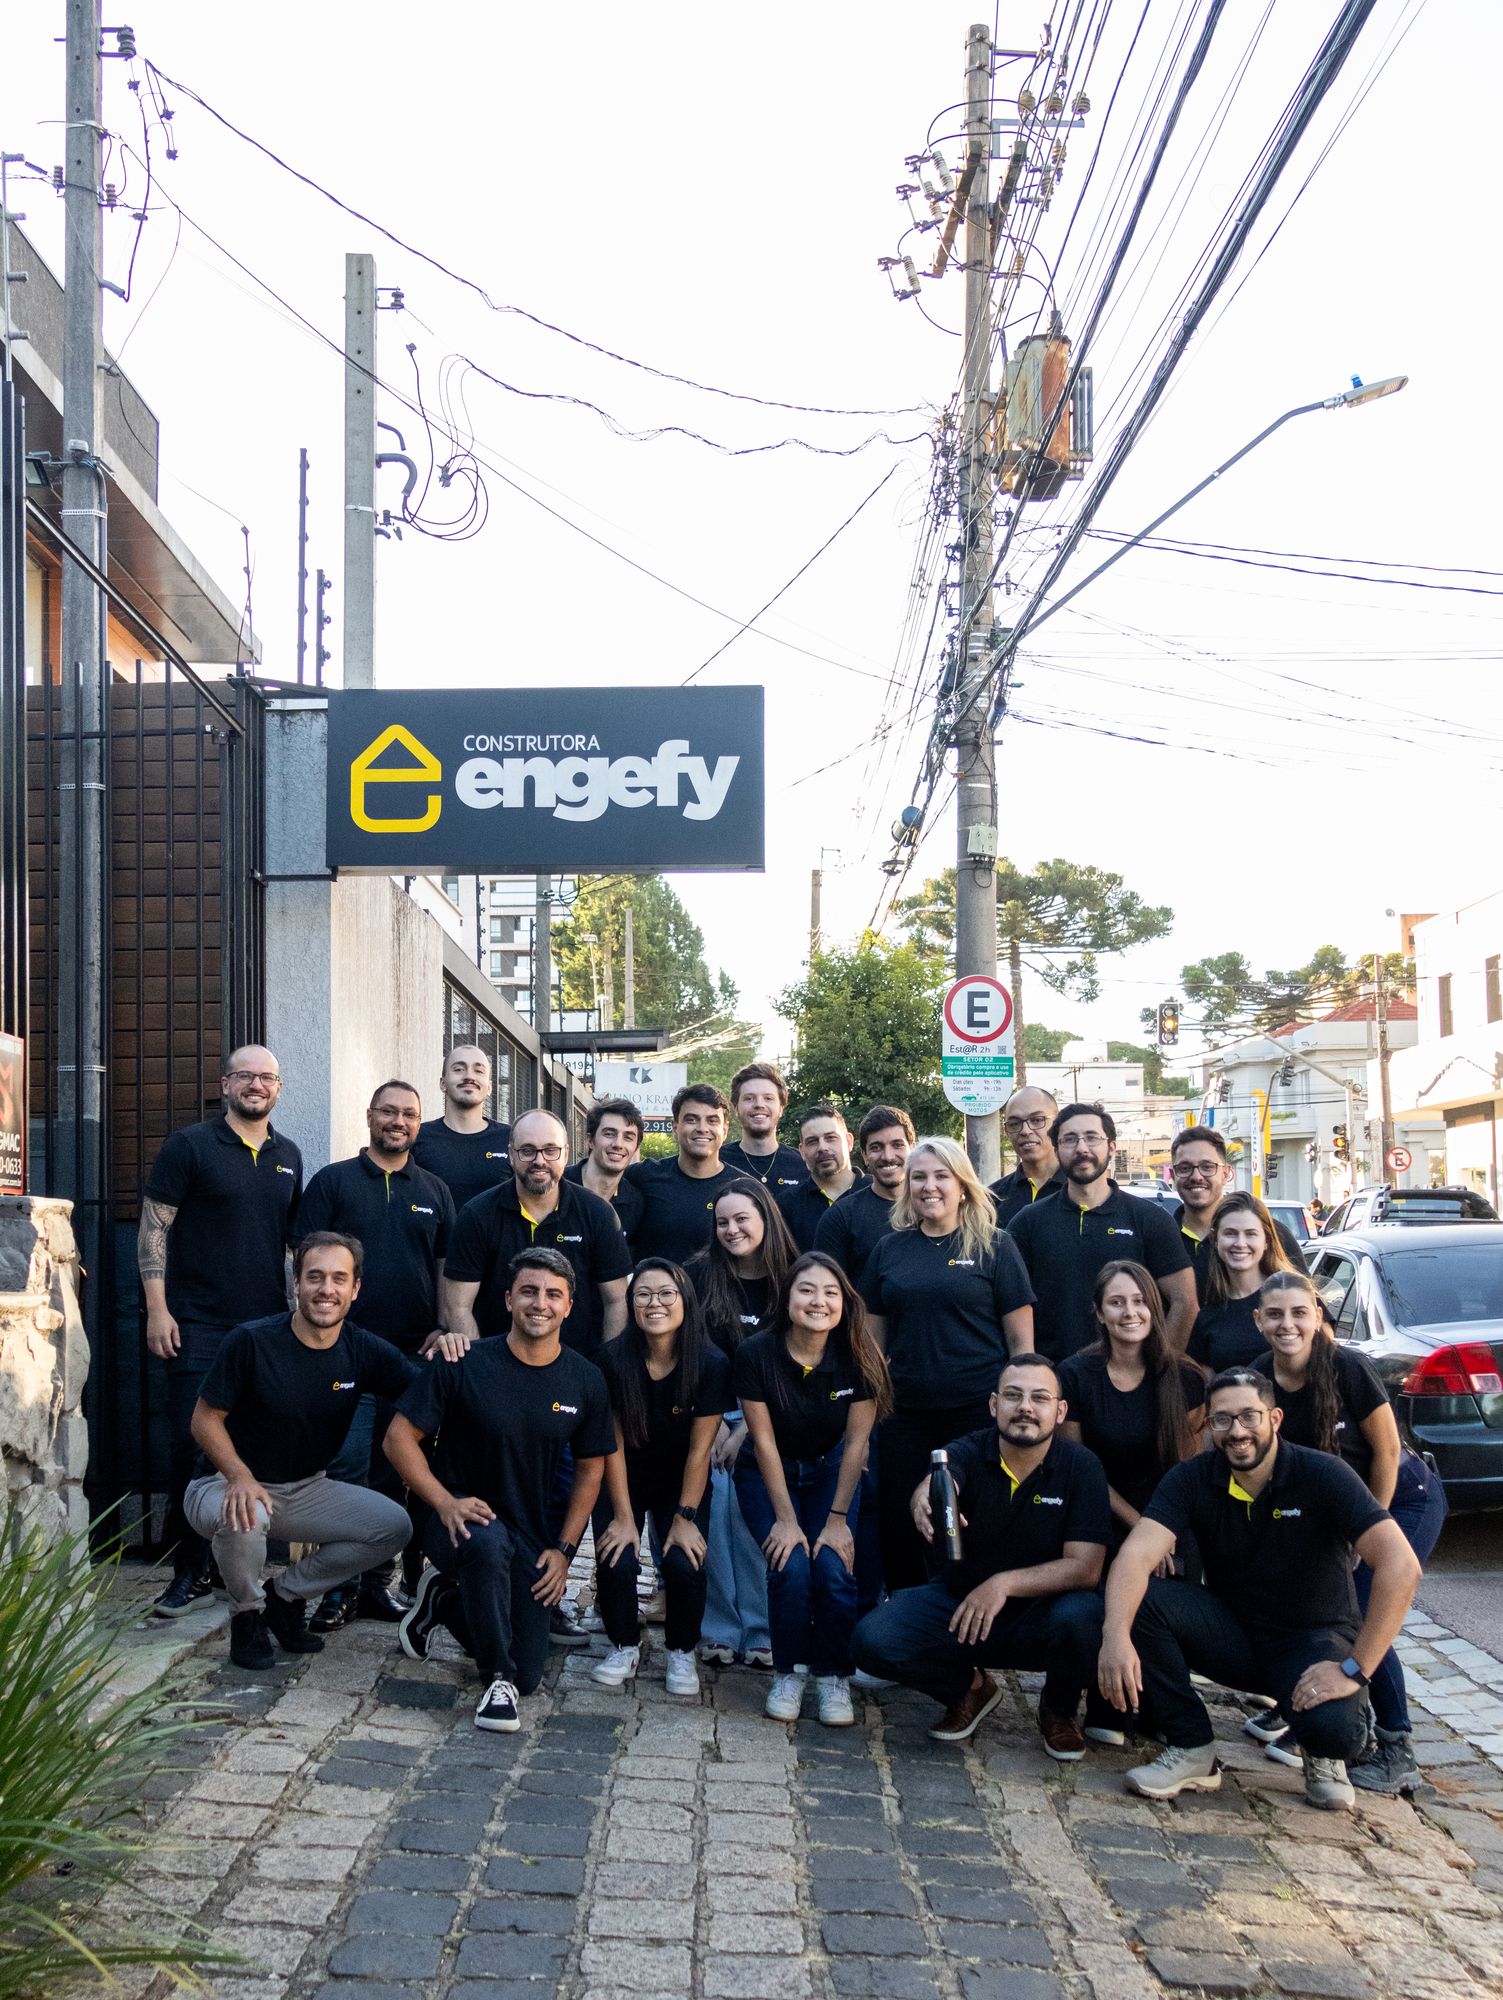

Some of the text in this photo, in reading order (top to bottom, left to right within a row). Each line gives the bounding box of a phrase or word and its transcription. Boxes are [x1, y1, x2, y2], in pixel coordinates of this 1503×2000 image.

[463, 734, 600, 752] CONSTRUTORA
[455, 739, 740, 822] engefy
[967, 991, 990, 1028] E
[949, 1044, 991, 1055] Est@R 2h
